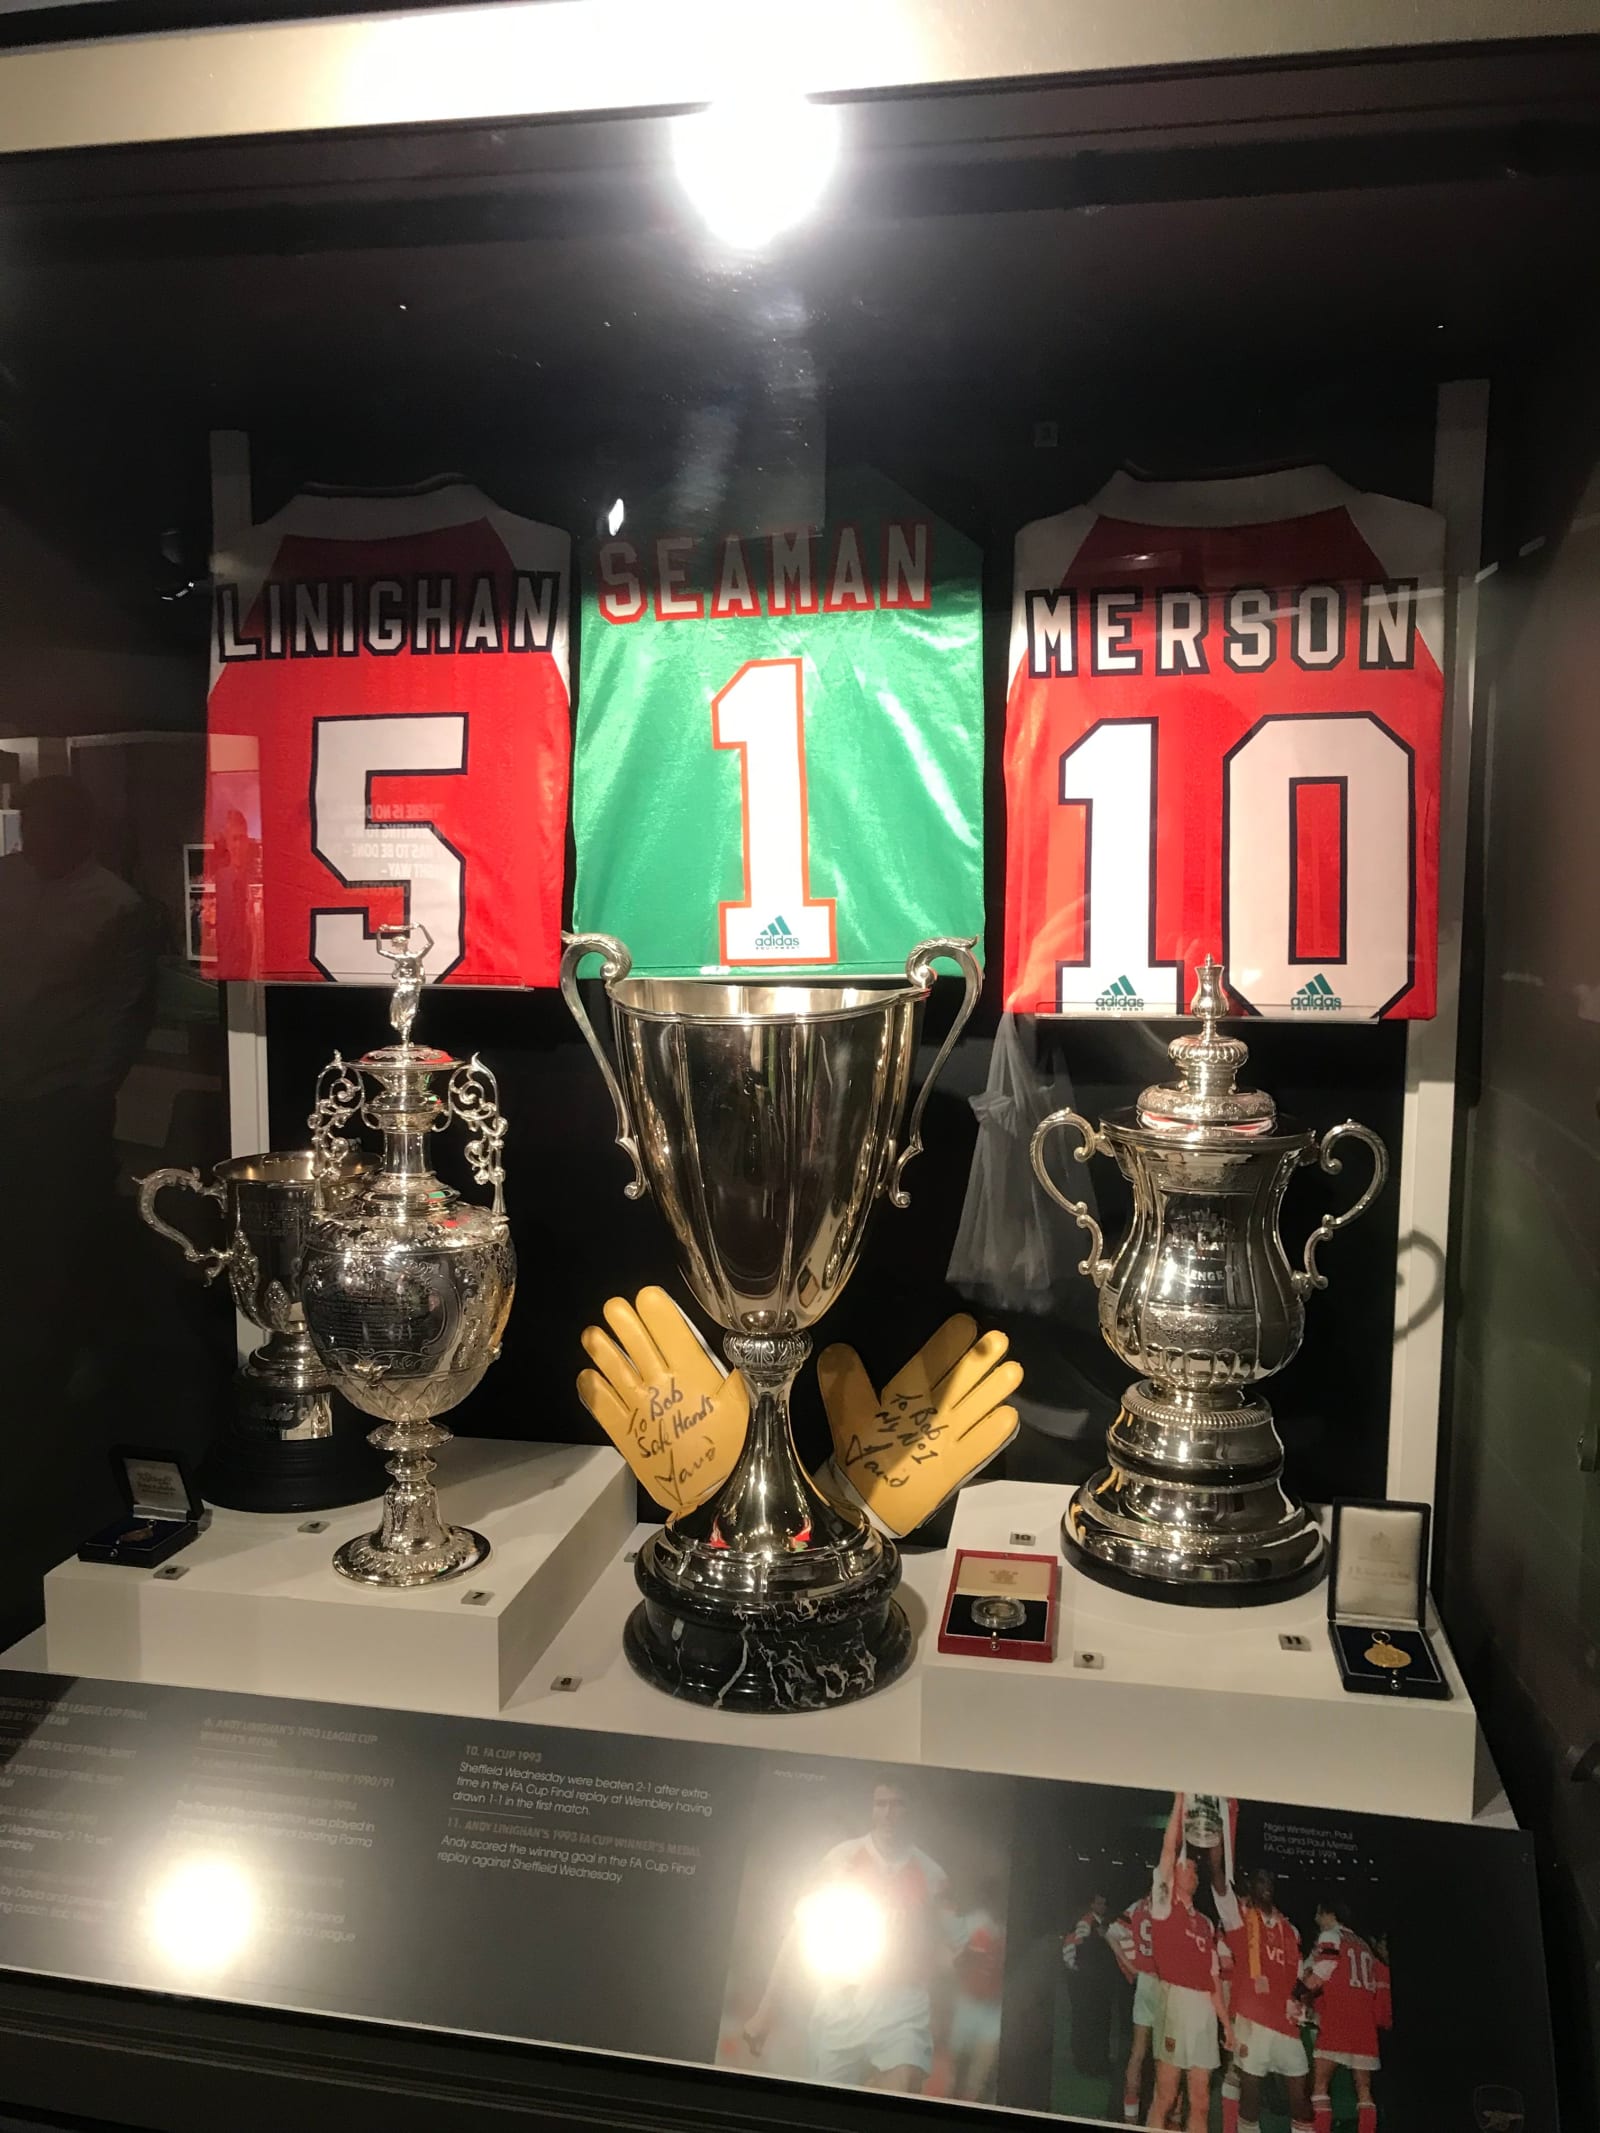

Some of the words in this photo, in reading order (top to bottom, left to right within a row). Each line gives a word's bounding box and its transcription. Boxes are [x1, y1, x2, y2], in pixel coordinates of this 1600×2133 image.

[599, 518, 932, 625] SEAMAN
[216, 571, 559, 663] LINIGHAN
[1026, 578, 1418, 678] MERSON
[711, 657, 838, 966] 1
[310, 712, 468, 983] 5
[1055, 711, 1415, 1019] 10
[755, 935, 800, 946] adidas
[1096, 995, 1144, 1007] adidas
[1291, 994, 1341, 1007] adidas
[648, 1377, 684, 1421] Bob
[1014, 1533, 1031, 1541] 10
[1285, 1636, 1303, 1645] 11
[358, 1734, 378, 1745] CUP
[483, 1747, 494, 1758] FA
[495, 1749, 516, 1760] CUP
[518, 1751, 543, 1763] 1993
[460, 1761, 503, 1776] Sheffield
[505, 1767, 566, 1784] Wednesday
[568, 1776, 593, 1786] were
[595, 1777, 634, 1791] beaten
[636, 1781, 651, 1793] 2-1
[654, 1783, 680, 1796] after
[452, 1792, 486, 1803] drawn
[490, 1794, 502, 1805] 1-1
[505, 1796, 514, 1807] in
[517, 1798, 534, 1809] the
[536, 1800, 553, 1811] first
[554, 1802, 591, 1816] match.
[457, 1776, 479, 1788] time
[481, 1778, 490, 1789] in
[492, 1780, 509, 1791] the
[511, 1782, 523, 1793] FA
[526, 1783, 548, 1797] Cup
[550, 1786, 575, 1799] Final
[576, 1791, 608, 1804] replay
[611, 1795, 622, 1804] at
[624, 1795, 674, 1812] Wembley
[676, 1801, 712, 1817] having
[328, 1818, 365, 1832] played
[366, 1822, 375, 1833] in
[339, 1833, 373, 1848] Parma
[464, 1820, 491, 1832] ANDY
[492, 1823, 550, 1839] LINIGHAN'S
[553, 1829, 578, 1842] 1993
[579, 1832, 590, 1844] FA
[592, 1834, 614, 1846] CUP
[614, 1837, 665, 1853] WINNER'S
[437, 1851, 471, 1865] replay
[472, 1856, 511, 1868] against
[512, 1858, 557, 1874] Sheffield
[560, 1863, 622, 1884] Wednesday
[441, 1835, 469, 1850] Andy
[470, 1840, 507, 1853] scored
[509, 1842, 527, 1855] the
[529, 1846, 569, 1863] winning
[571, 1852, 595, 1864] goal
[598, 1854, 607, 1864] in
[609, 1855, 628, 1867] the
[629, 1857, 642, 1868] FA
[645, 1859, 668, 1873] Cup
[671, 1862, 696, 1876] Final
